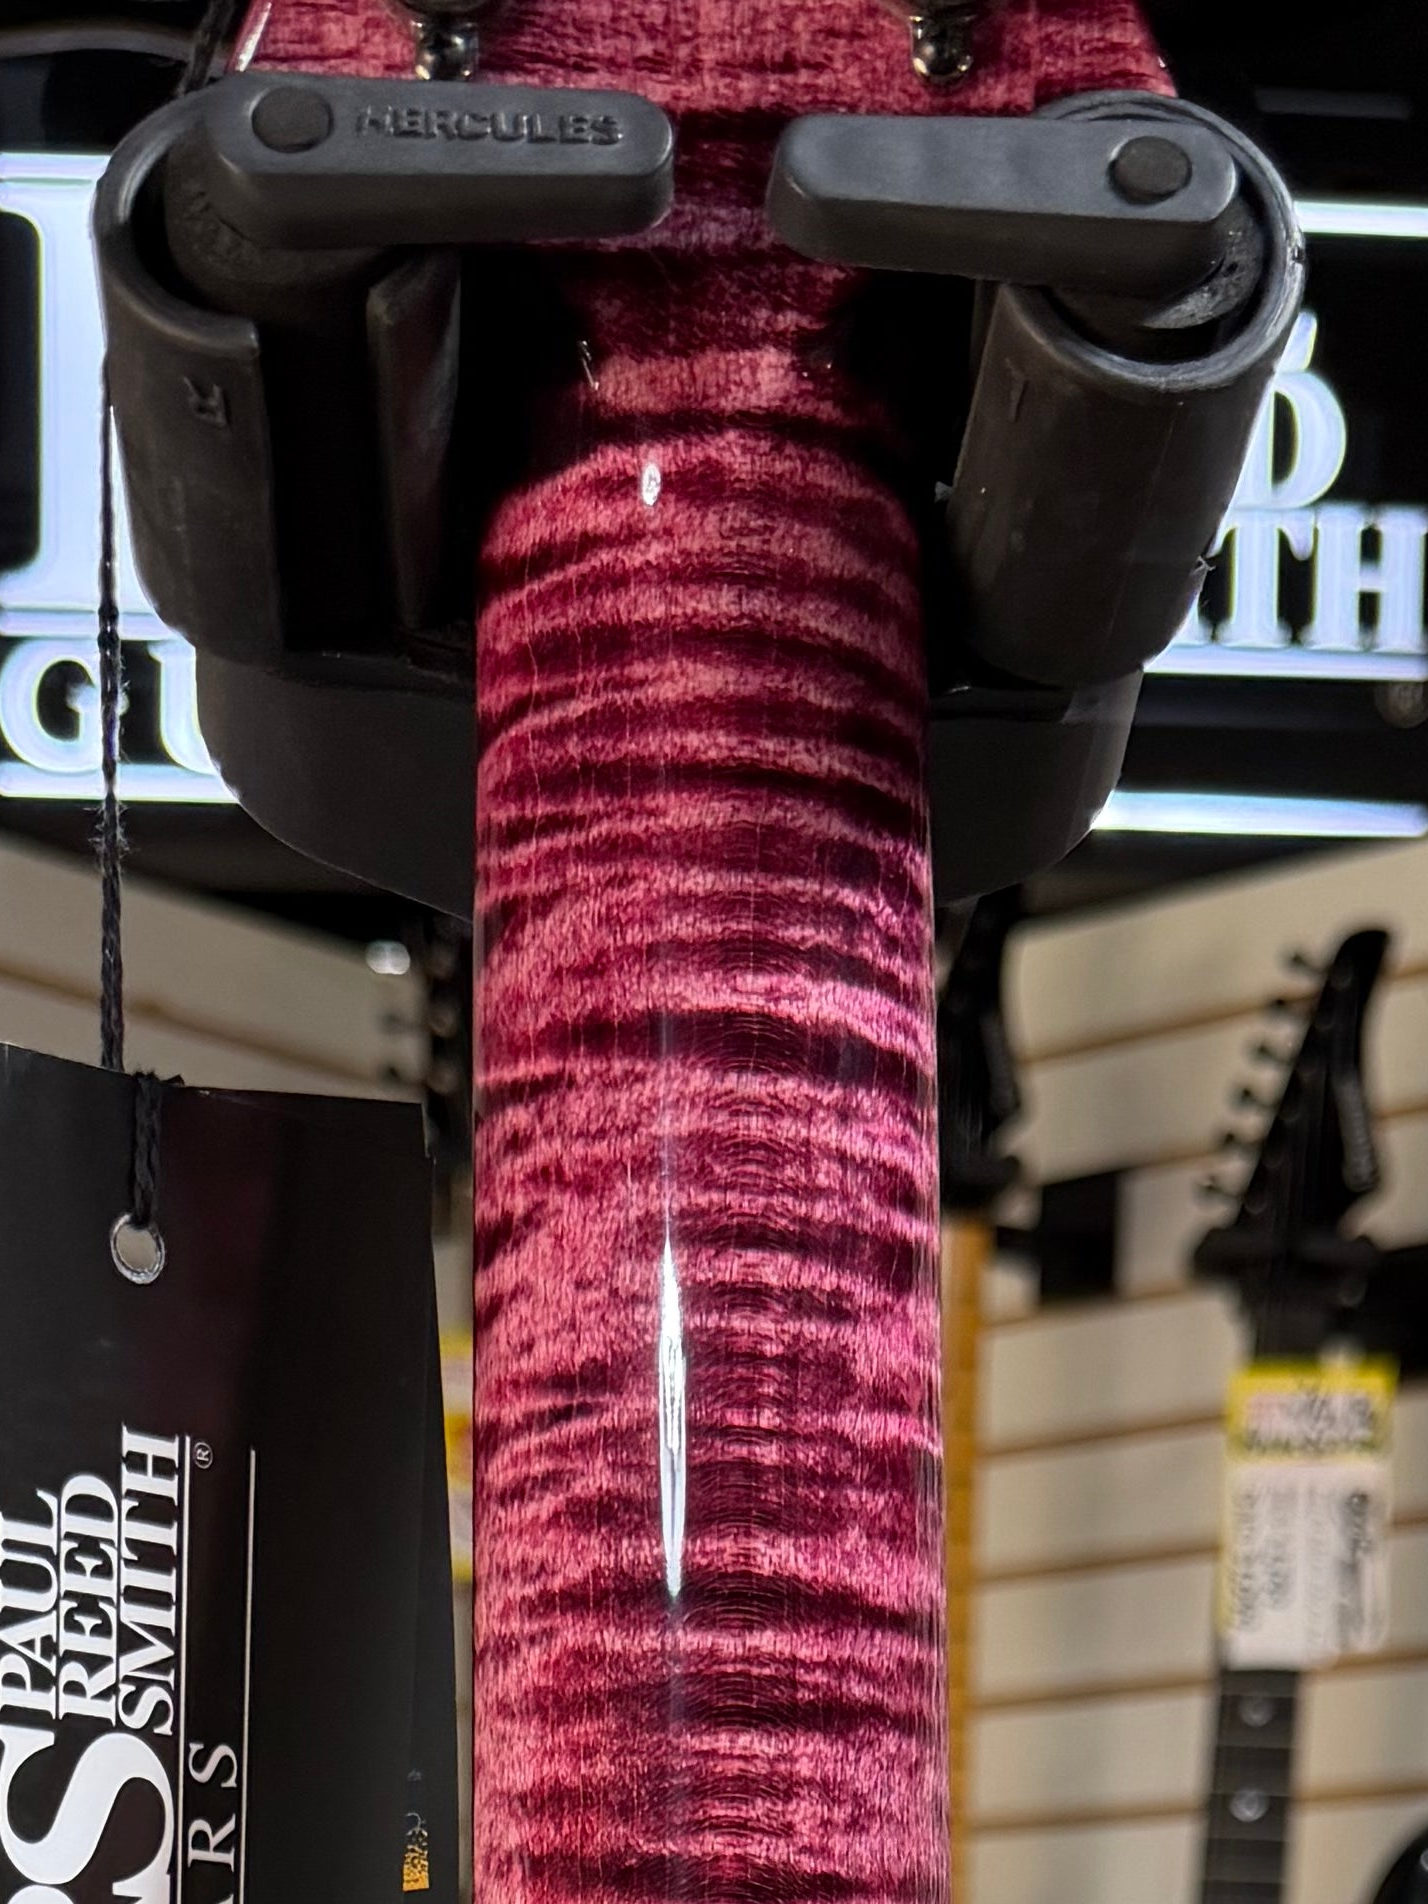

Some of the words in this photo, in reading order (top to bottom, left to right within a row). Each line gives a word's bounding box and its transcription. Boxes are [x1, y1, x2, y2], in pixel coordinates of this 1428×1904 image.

[355, 104, 624, 146] HERCULES
[58, 1474, 119, 1727] REED
[117, 1421, 180, 1736] SMITH
